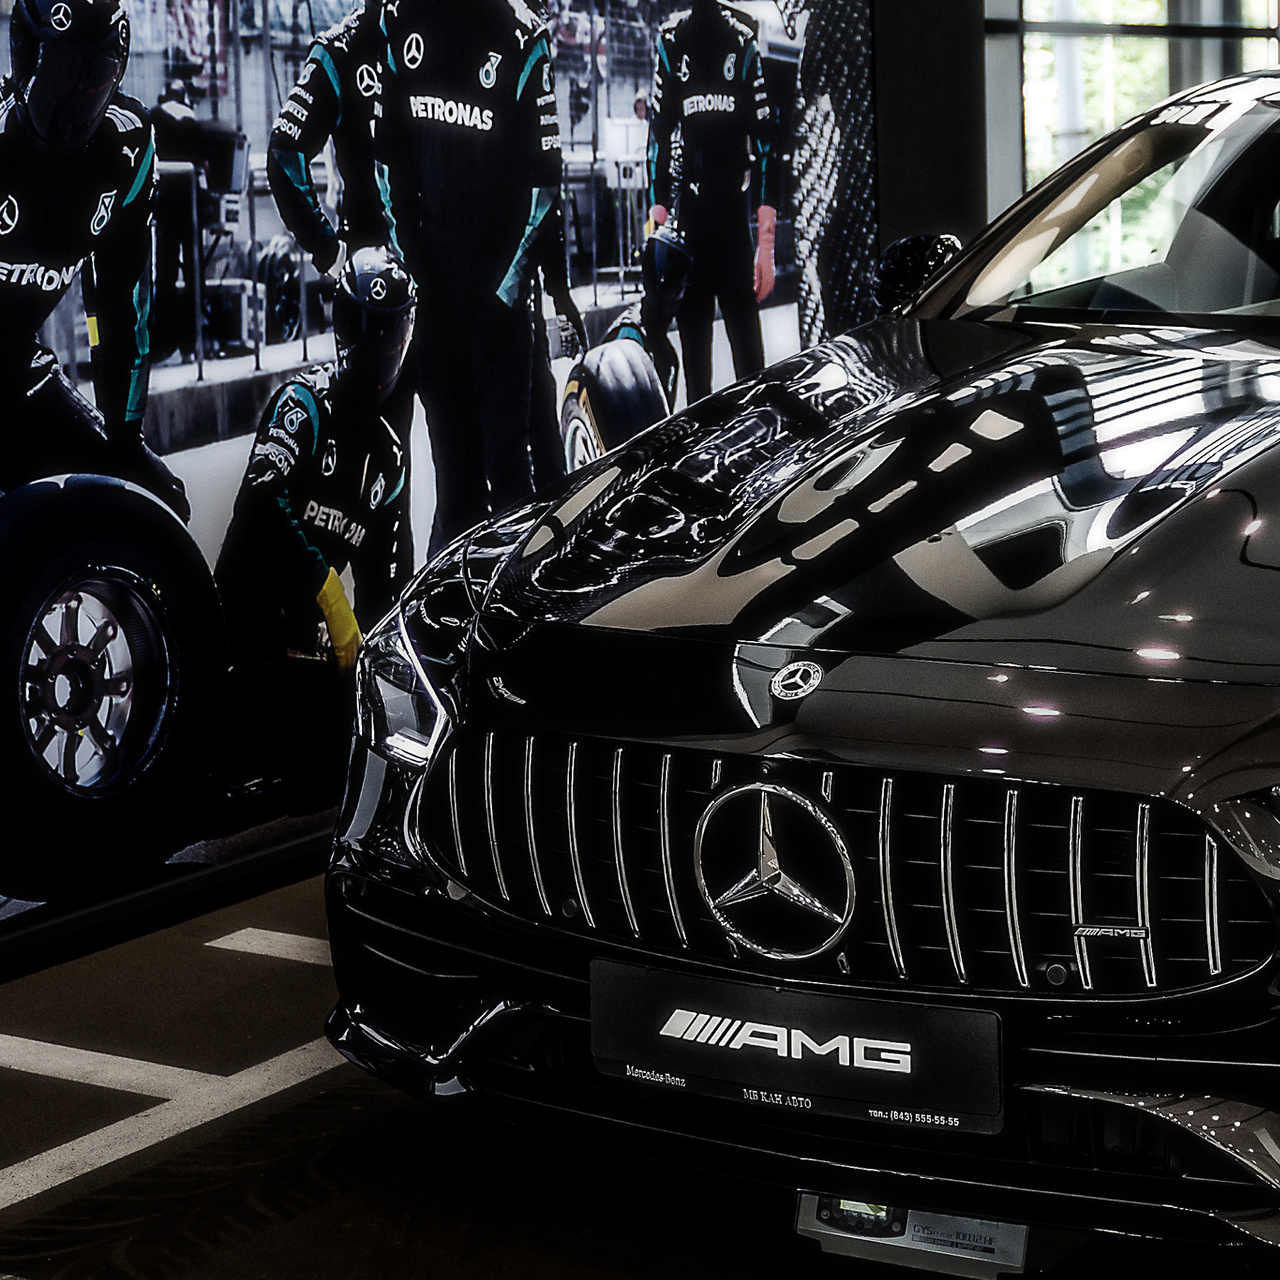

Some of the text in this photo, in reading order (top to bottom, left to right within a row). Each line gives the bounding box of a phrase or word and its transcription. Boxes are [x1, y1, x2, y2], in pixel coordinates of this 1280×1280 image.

[410, 95, 494, 131] PETRONAS
[1096, 928, 1146, 937] AMG
[728, 1022, 911, 1073] AMG
[626, 1064, 686, 1087] Mercedes-Benz
[760, 1091, 783, 1105] КАН
[784, 1096, 812, 1109] АВТО
[890, 1110, 913, 1123] (843)
[915, 1113, 960, 1126] 555-55-55
